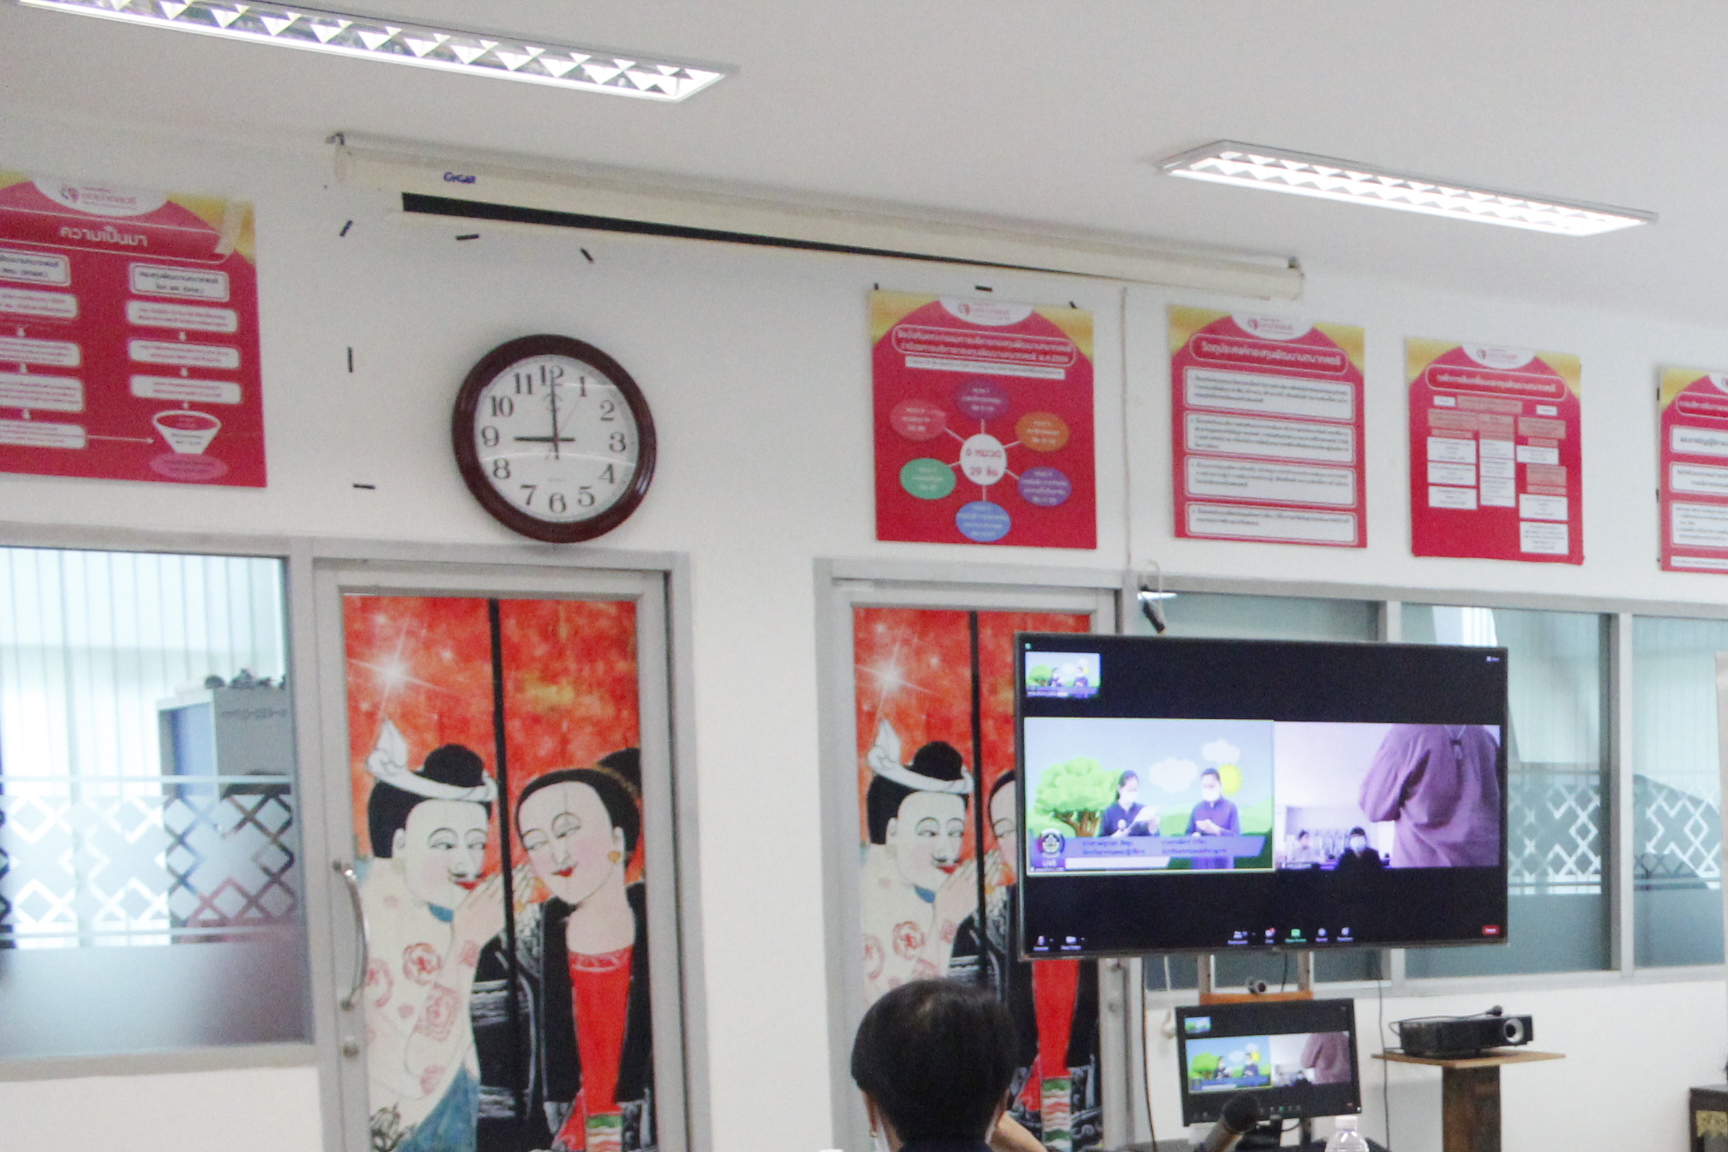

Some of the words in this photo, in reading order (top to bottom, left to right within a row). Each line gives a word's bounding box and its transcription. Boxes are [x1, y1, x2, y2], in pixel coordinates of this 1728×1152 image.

[59, 225, 149, 248] ความเป็นมา
[513, 373, 534, 396] 11
[538, 364, 565, 387] 12
[578, 376, 588, 398] 1
[490, 395, 514, 418] 10
[600, 399, 615, 421] 2
[480, 425, 500, 448] 9
[609, 431, 627, 453] 3
[493, 458, 511, 480] 8
[598, 463, 615, 485] 4
[520, 483, 537, 506] 7
[549, 492, 567, 514] 6
[577, 485, 595, 508] 5
